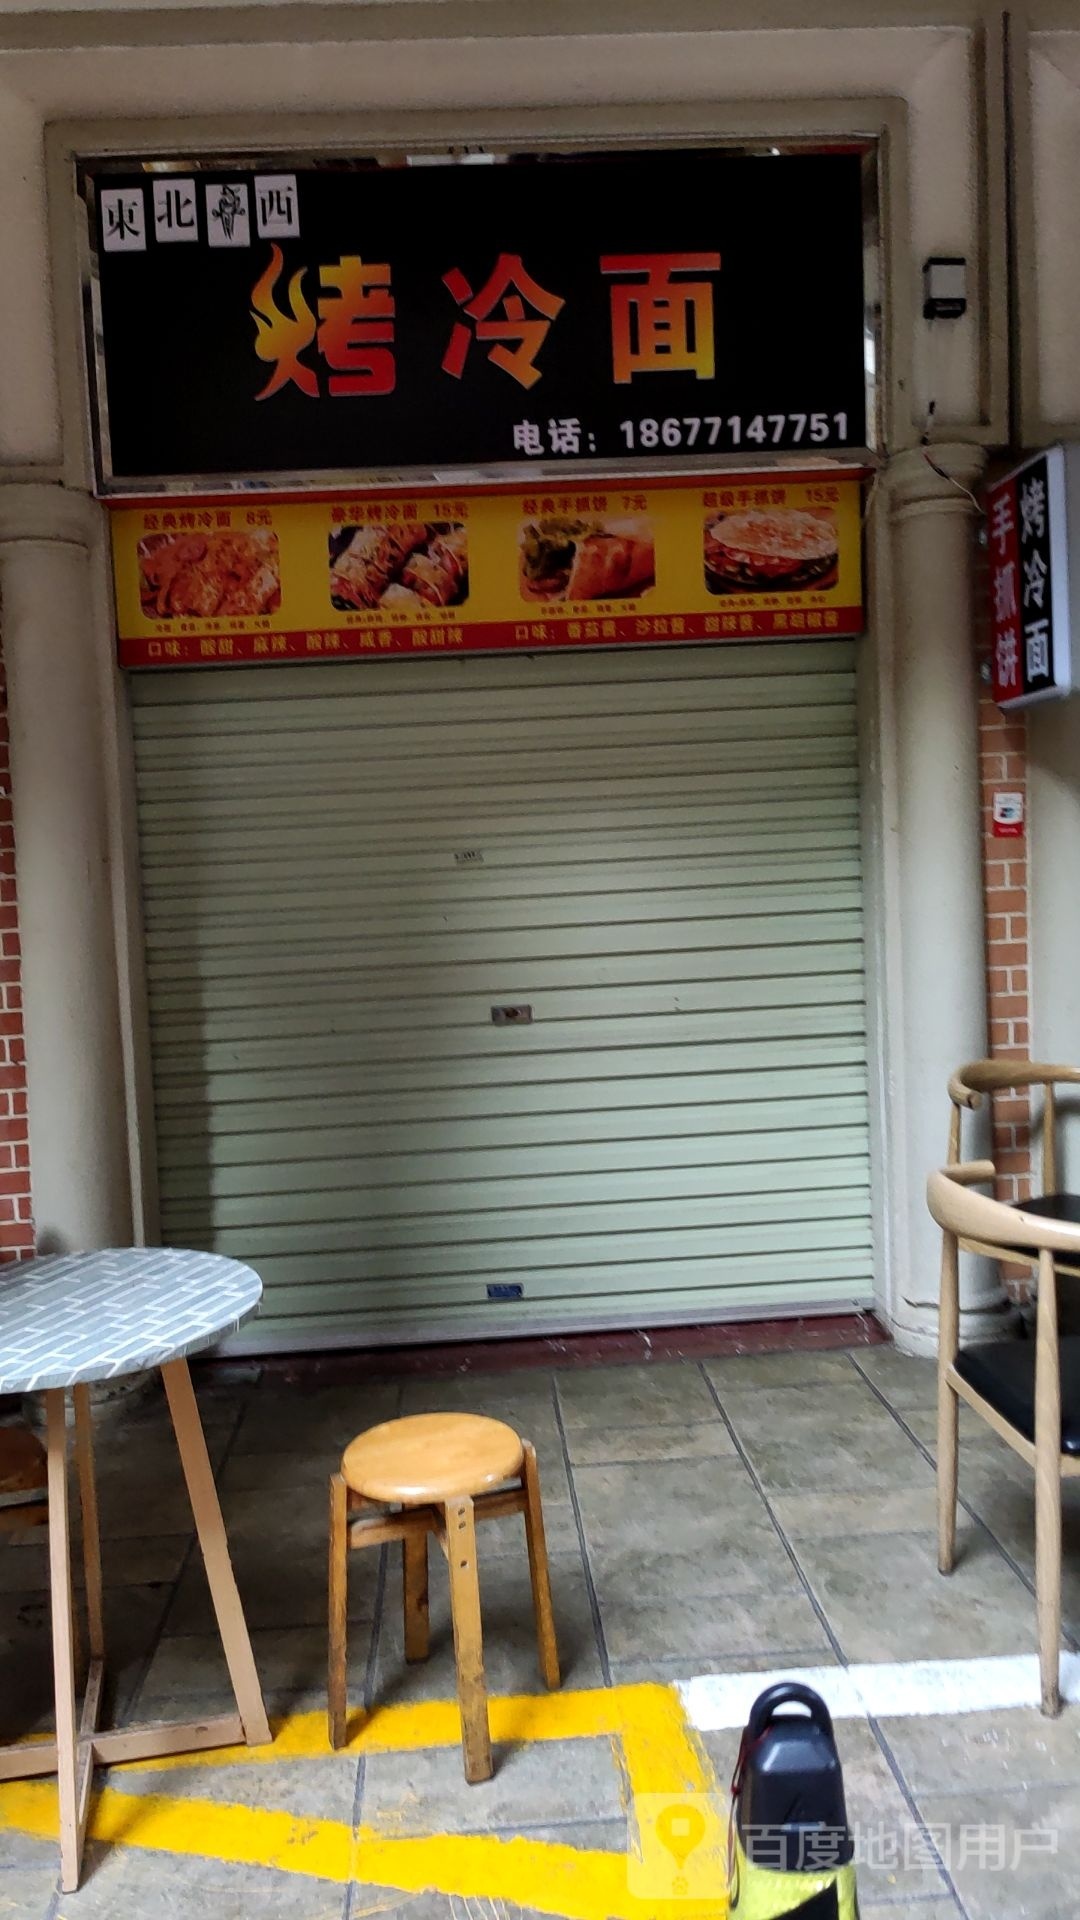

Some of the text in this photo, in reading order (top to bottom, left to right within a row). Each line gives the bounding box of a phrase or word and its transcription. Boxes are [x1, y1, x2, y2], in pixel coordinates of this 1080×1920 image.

[248, 242, 722, 401] 烤冷面
[620, 413, 849, 449] 18677147751
[143, 508, 231, 531] 经典烤冷面
[1021, 478, 1050, 683] 烤冷面
